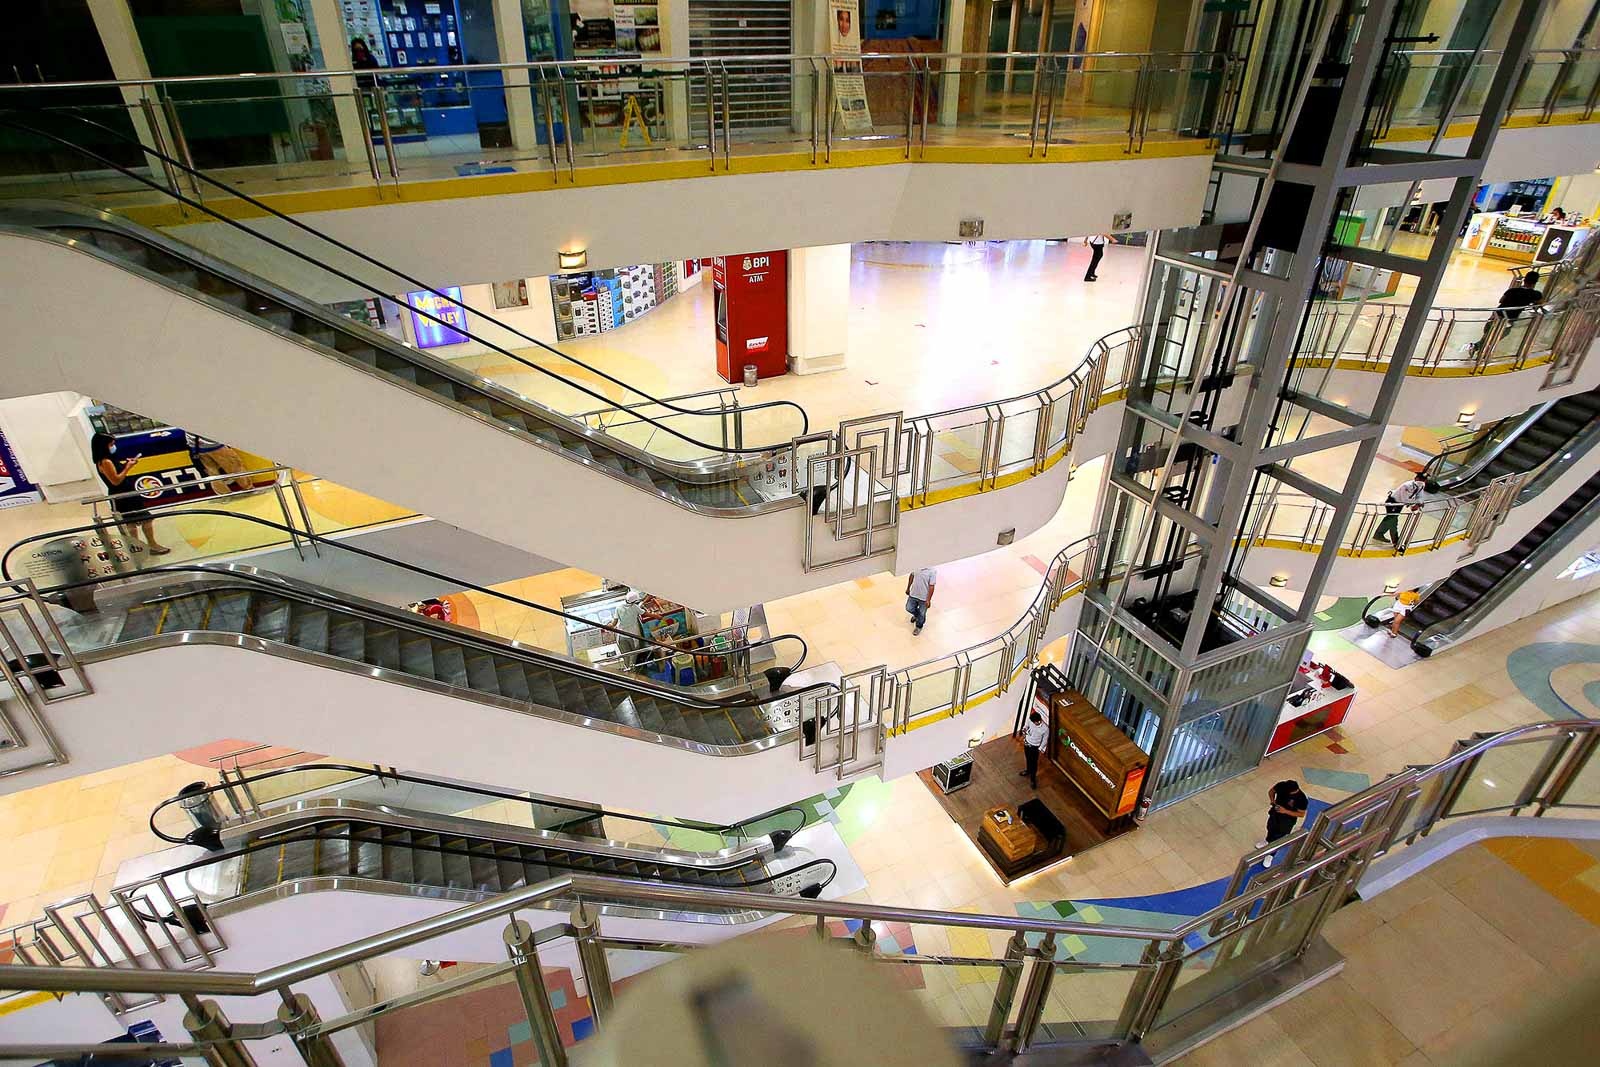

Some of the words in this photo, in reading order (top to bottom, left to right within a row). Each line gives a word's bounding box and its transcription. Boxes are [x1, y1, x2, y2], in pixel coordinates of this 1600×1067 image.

[753, 256, 769, 268] BPI
[749, 274, 763, 283] ATM
[32, 550, 63, 558] CAUTION
